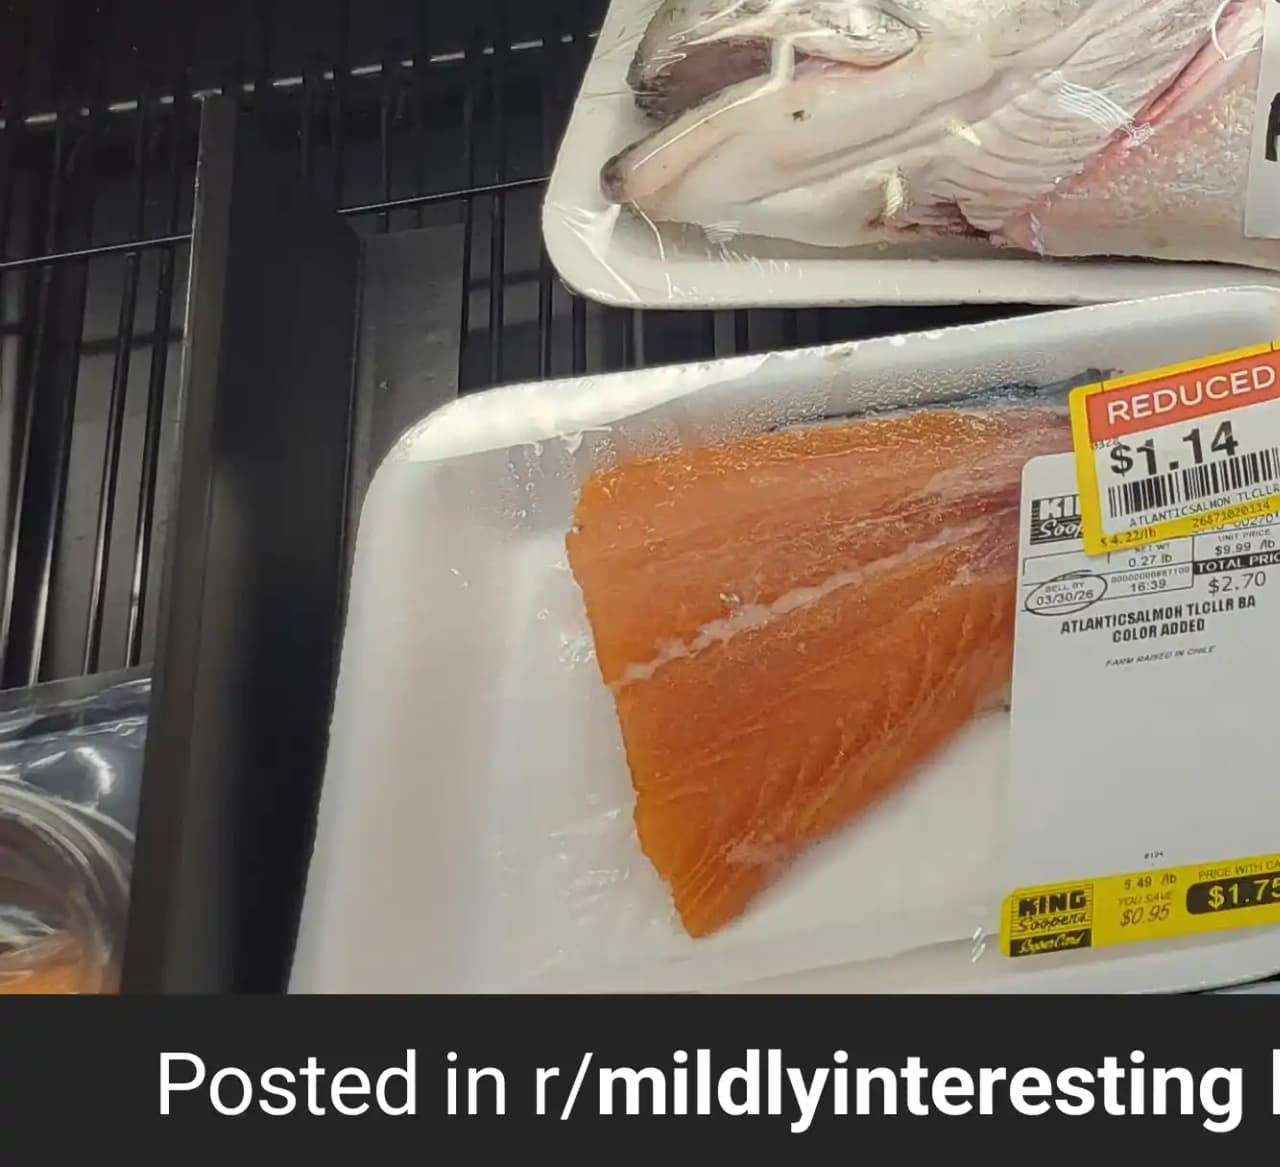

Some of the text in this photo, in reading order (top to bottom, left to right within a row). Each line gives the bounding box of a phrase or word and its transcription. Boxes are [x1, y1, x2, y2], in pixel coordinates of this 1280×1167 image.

[1107, 365, 1276, 424] REDUCED
[1110, 420, 1238, 477] $1.14
[1129, 497, 1230, 527] ATLANTICSALMON
[1238, 483, 1280, 501] TLCLLR
[1198, 557, 1242, 574] TOTAL
[1131, 580, 1166, 593] 16:39
[1208, 571, 1266, 596] $2.70
[1036, 589, 1094, 606] 03/30/26
[1061, 595, 1256, 634] ATLANTICSALMON TLCLLR BA
[1112, 618, 1205, 643] COLOR ADDED
[1198, 867, 1231, 880] PRICE
[1234, 862, 1263, 874] WITH
[1019, 890, 1086, 917] KING
